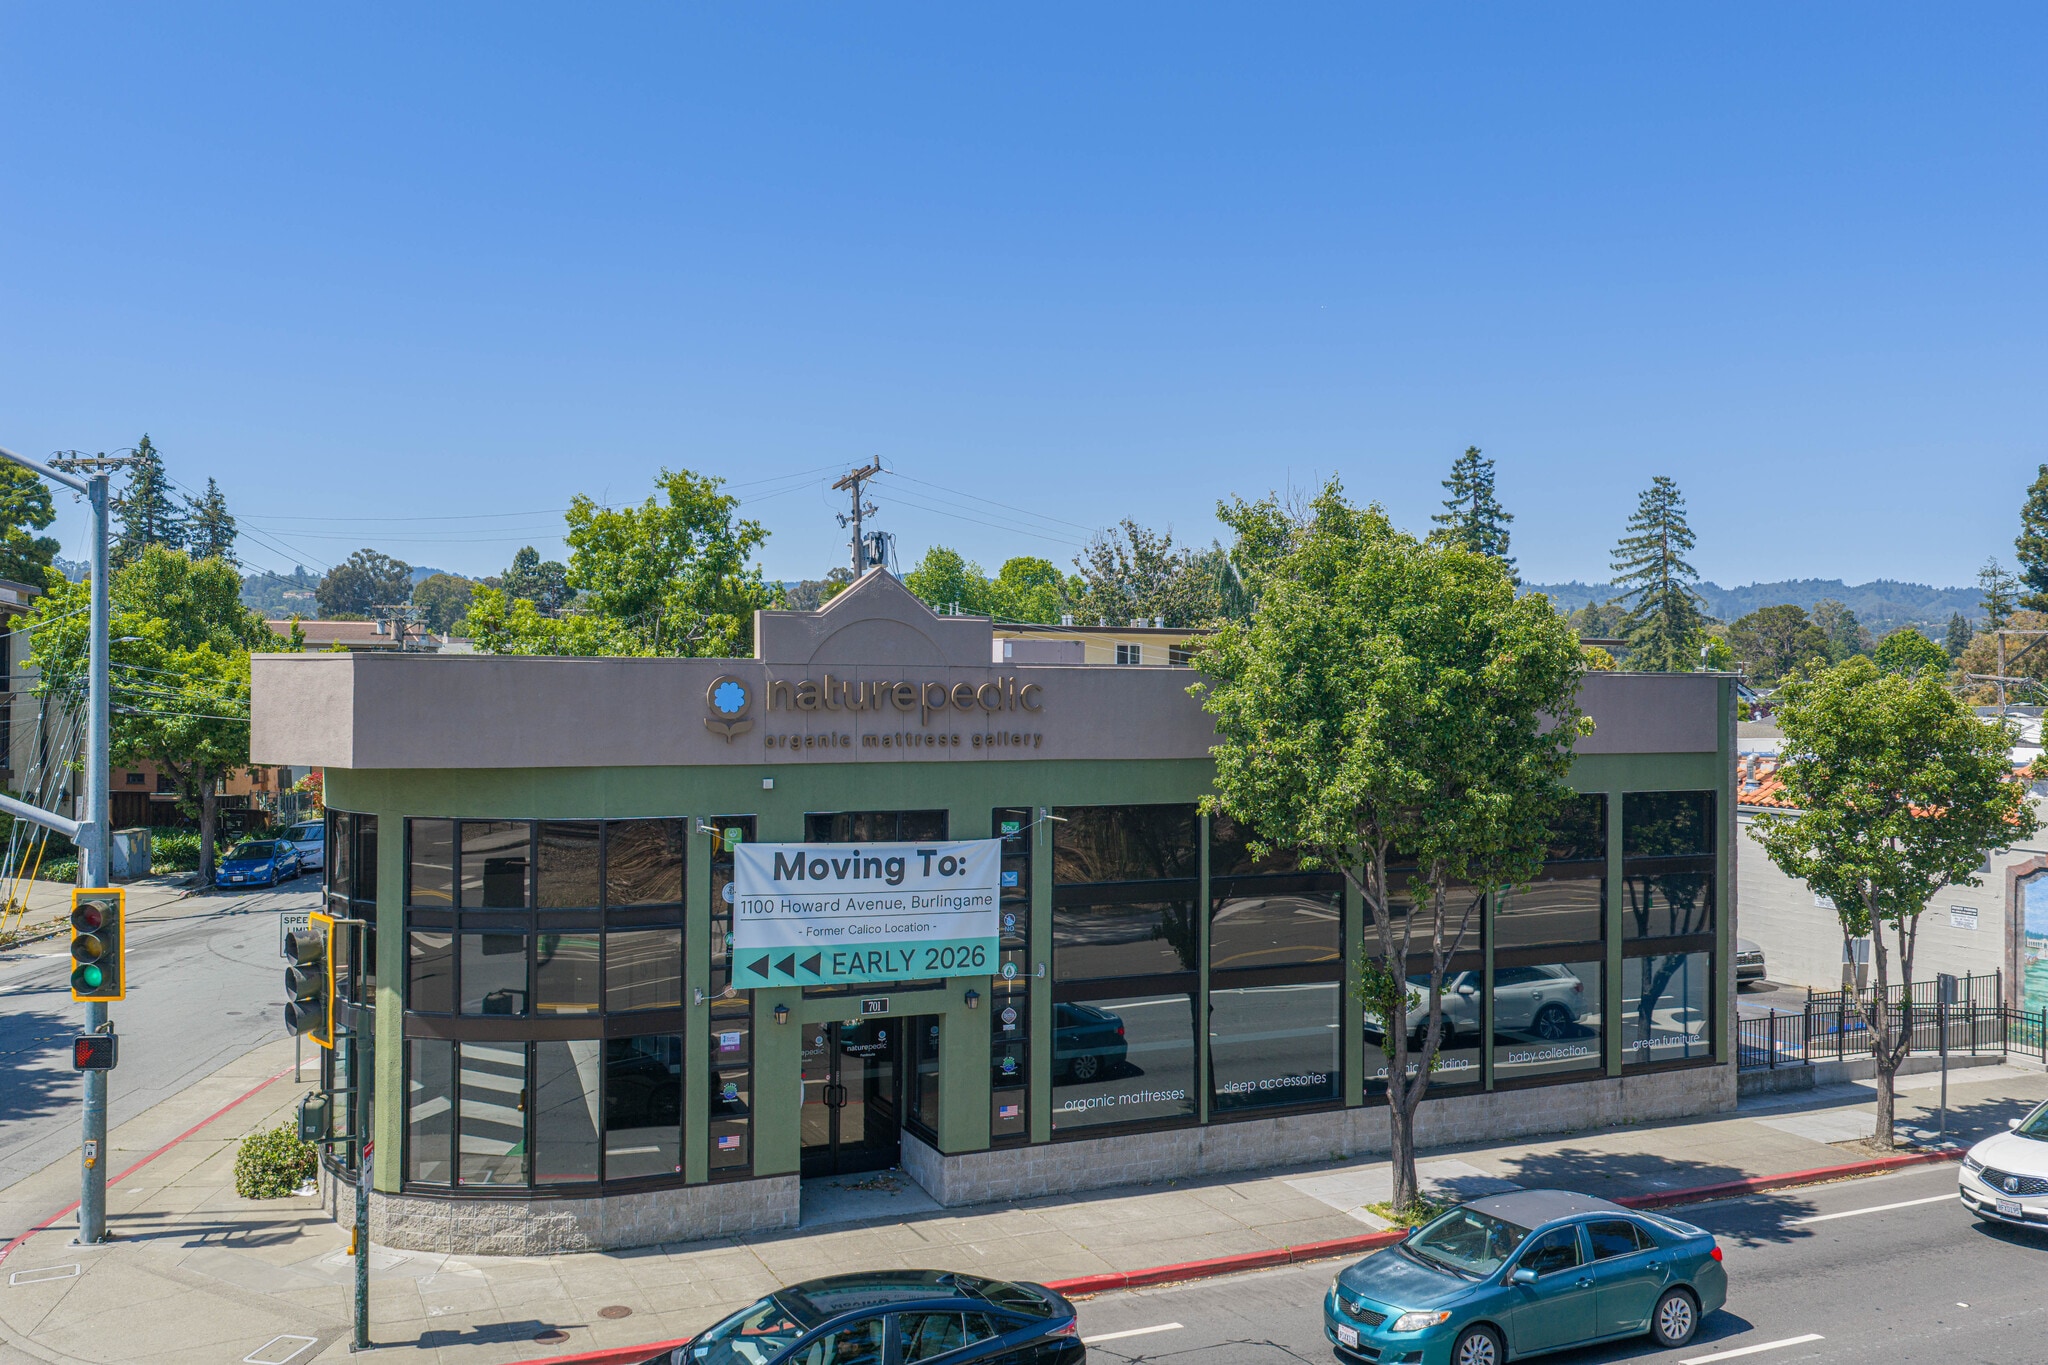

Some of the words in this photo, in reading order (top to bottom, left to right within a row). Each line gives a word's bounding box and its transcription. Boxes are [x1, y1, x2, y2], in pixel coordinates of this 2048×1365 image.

[766, 674, 1043, 727] naturepedic
[765, 732, 851, 750] organic
[862, 732, 961, 748] mattress
[971, 732, 1043, 749] gallery
[773, 849, 906, 886] Moving
[916, 849, 966, 877] To:
[740, 899, 775, 914] 1100
[780, 898, 840, 913] Howard
[845, 898, 907, 911] Avenue,
[911, 895, 993, 911] Burlingame
[283, 916, 309, 924] SPEE
[806, 925, 845, 937] Former
[848, 924, 882, 935] Calico
[885, 922, 930, 934] Location
[832, 949, 916, 976] EARLY
[925, 944, 986, 971] 2026
[868, 1001, 881, 1012] 701
[846, 1041, 887, 1052] naturepedic
[1632, 1038, 1660, 1052] green
[1662, 1033, 1700, 1046] furniture
[1508, 1050, 1536, 1064] baby
[1538, 1044, 1588, 1060] collection
[1377, 1062, 1419, 1077] ornic
[1224, 1081, 1256, 1094] sleep
[1259, 1072, 1327, 1090] accessories
[1064, 1093, 1115, 1112] organic
[1118, 1088, 1185, 1105] mattresses
